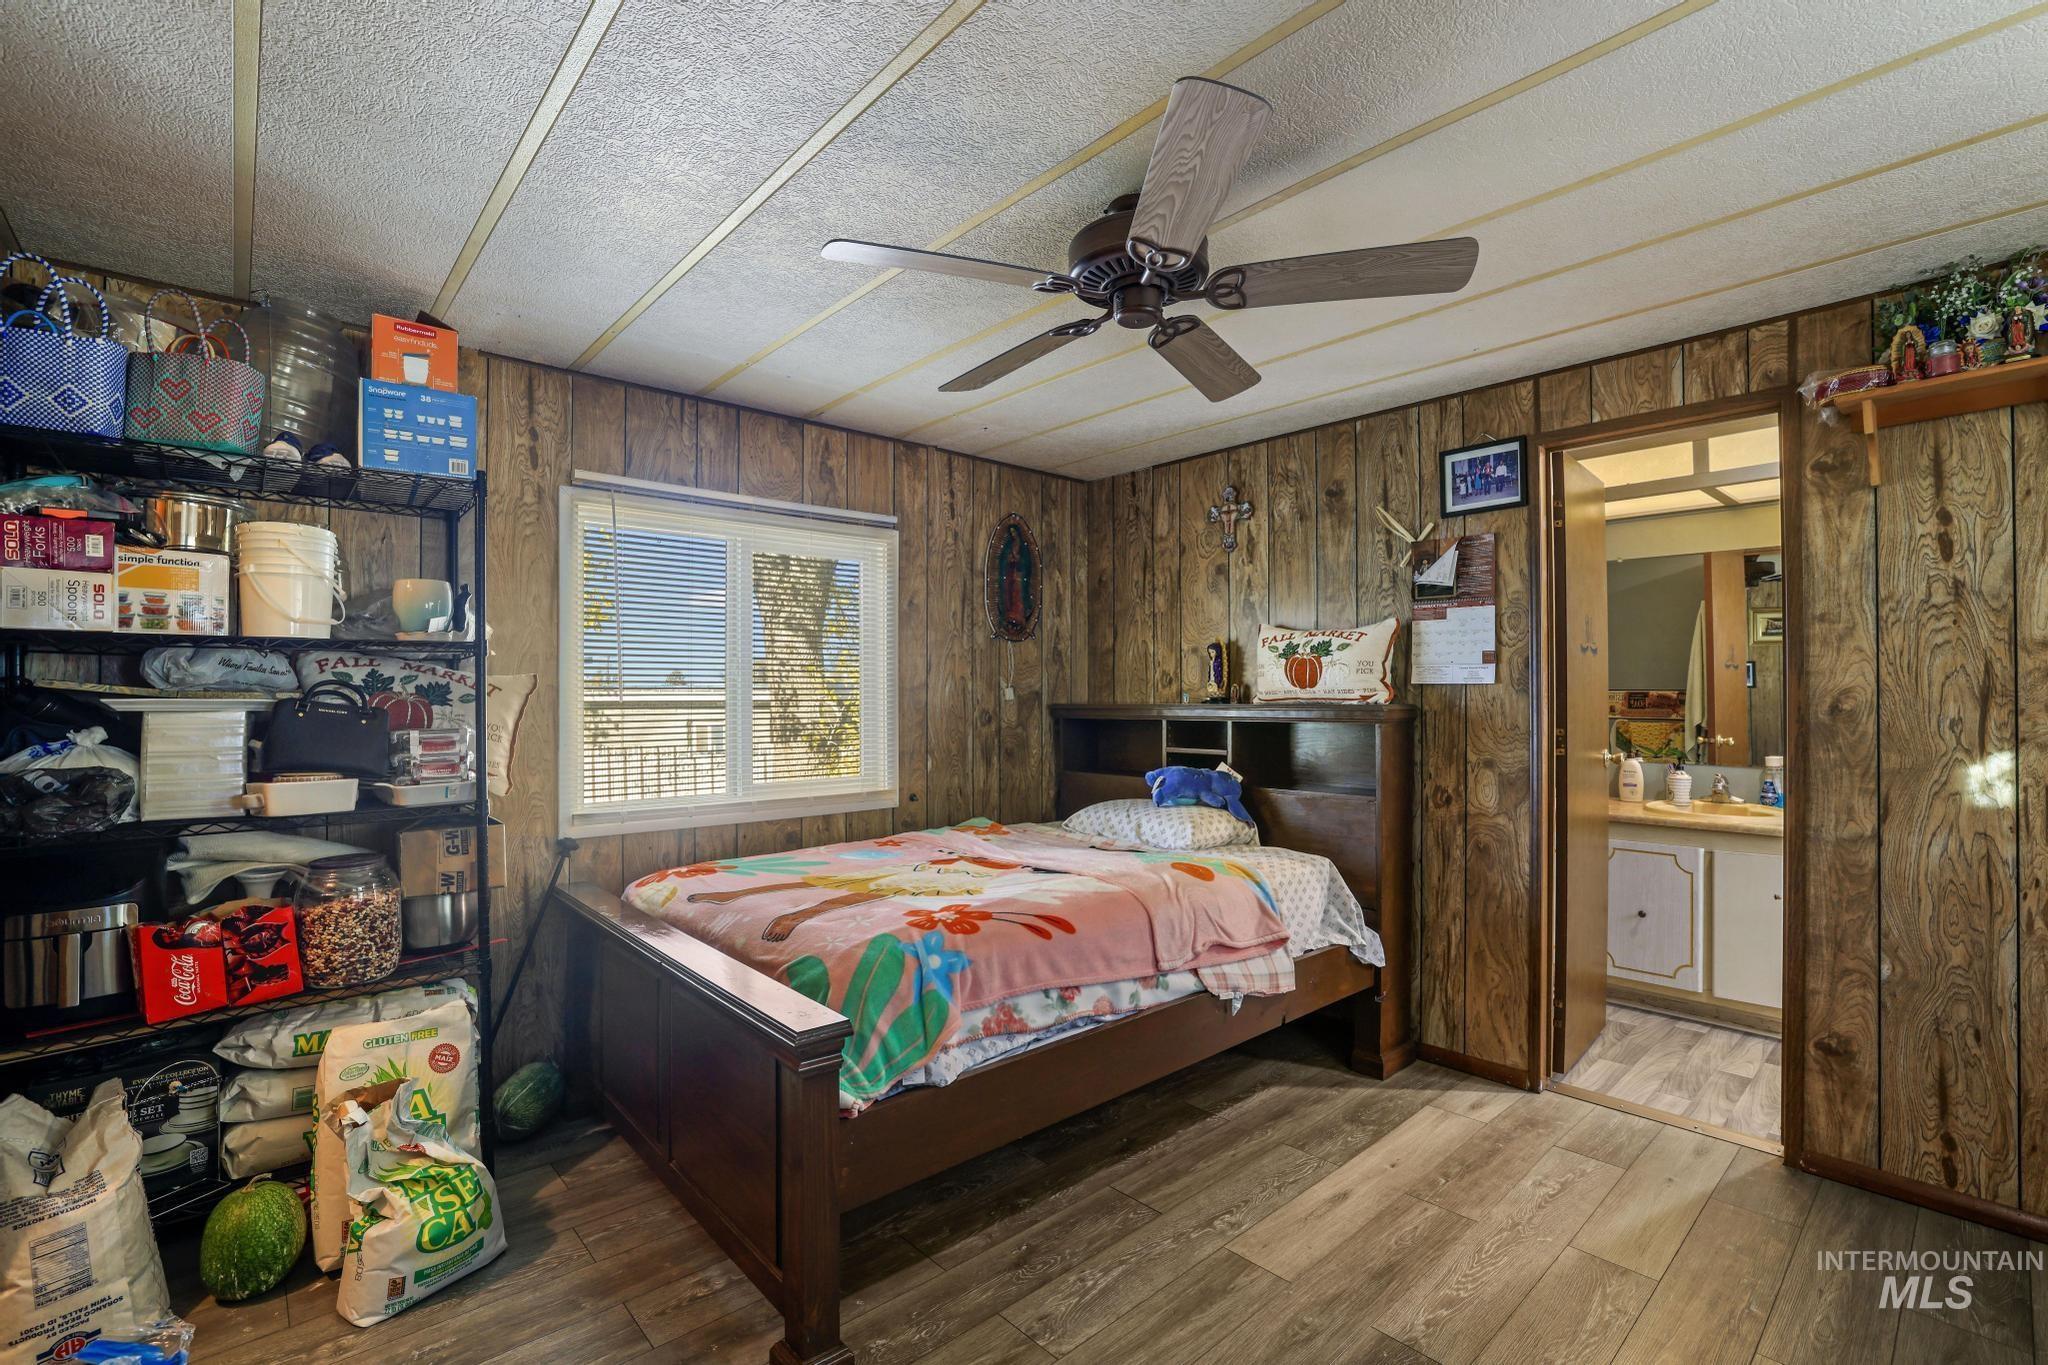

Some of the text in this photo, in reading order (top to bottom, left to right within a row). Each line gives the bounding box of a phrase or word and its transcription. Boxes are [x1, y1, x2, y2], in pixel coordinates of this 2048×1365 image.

[396, 324, 436, 337] Rubbermaid
[368, 386, 406, 397] Snapware
[420, 395, 432, 403] 38
[4, 520, 20, 561] SOLO
[32, 526, 46, 558] Forks
[66, 536, 76, 552] 500
[118, 554, 200, 567] simple function
[37, 591, 47, 606] 500
[66, 579, 80, 621] Spoons
[93, 584, 105, 620] SOLO
[1262, 630, 1368, 648] FALL MARKET
[315, 656, 503, 698] FALL MARKT
[170, 954, 197, 1006] Coca-Cola
[363, 1027, 439, 1049] GLUTEN FREE
[50, 1088, 83, 1102] THYME
[140, 1104, 165, 1117] SET
[433, 1171, 481, 1215] SE
[47, 1198, 97, 1219] IMPORTANT
[12, 1216, 45, 1231] NOTICE
[420, 1210, 473, 1251] CA
[91, 1295, 111, 1308] TWIN
[8, 1295, 124, 1346] SORANCO BEAN PRODUCTS
[59, 1304, 89, 1319] FALLS,
[20, 1323, 46, 1336] 83301
[46, 1318, 90, 1340] PACKED BY
